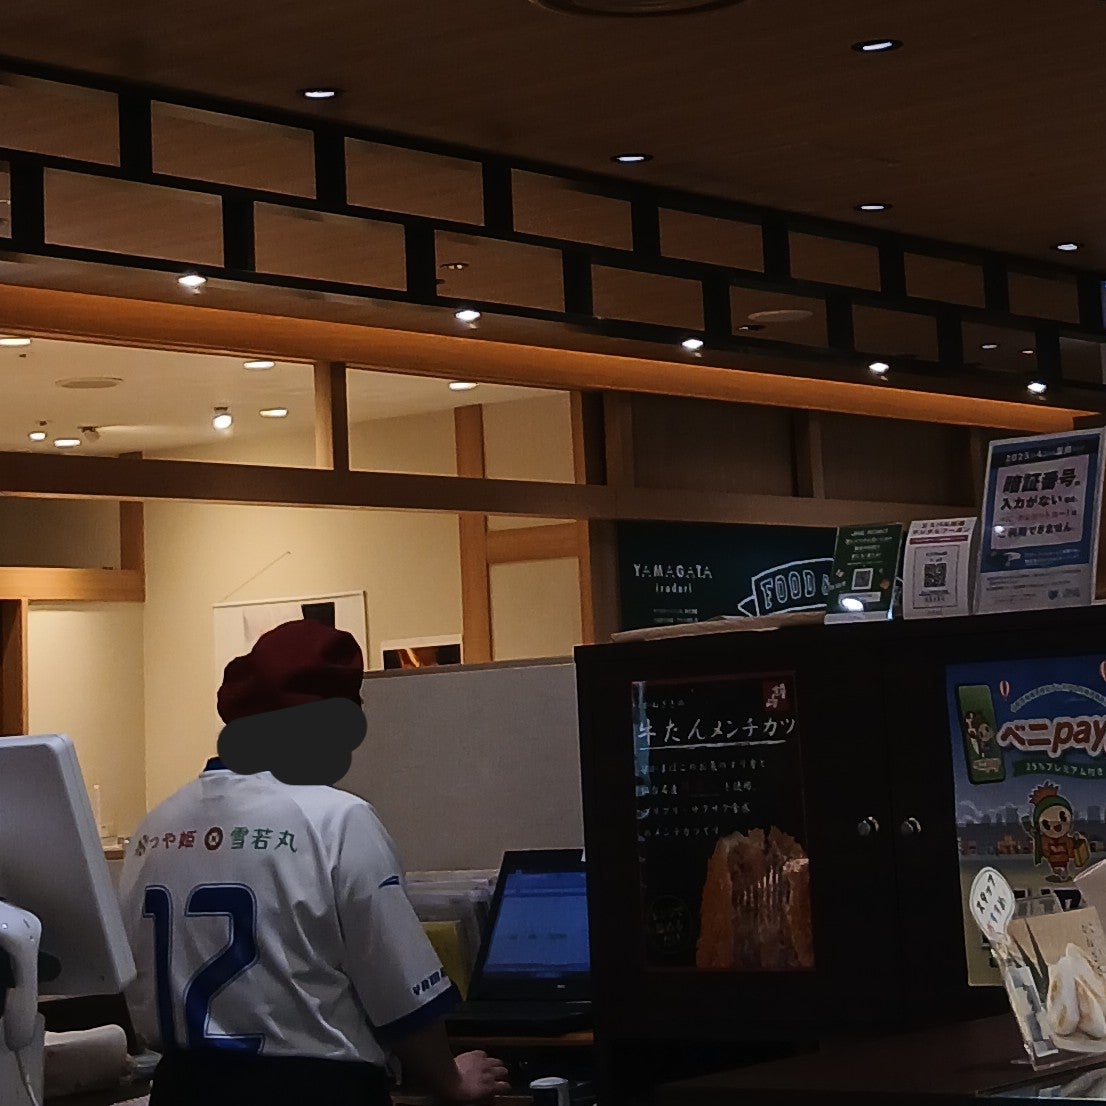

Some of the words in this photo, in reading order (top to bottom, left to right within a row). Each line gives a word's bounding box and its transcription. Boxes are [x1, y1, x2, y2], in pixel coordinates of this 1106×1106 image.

[632, 562, 713, 580] YAMAGATA
[760, 569, 816, 609] FOOD
[230, 826, 297, 853] 雪若丸
[142, 883, 265, 1056] 12
